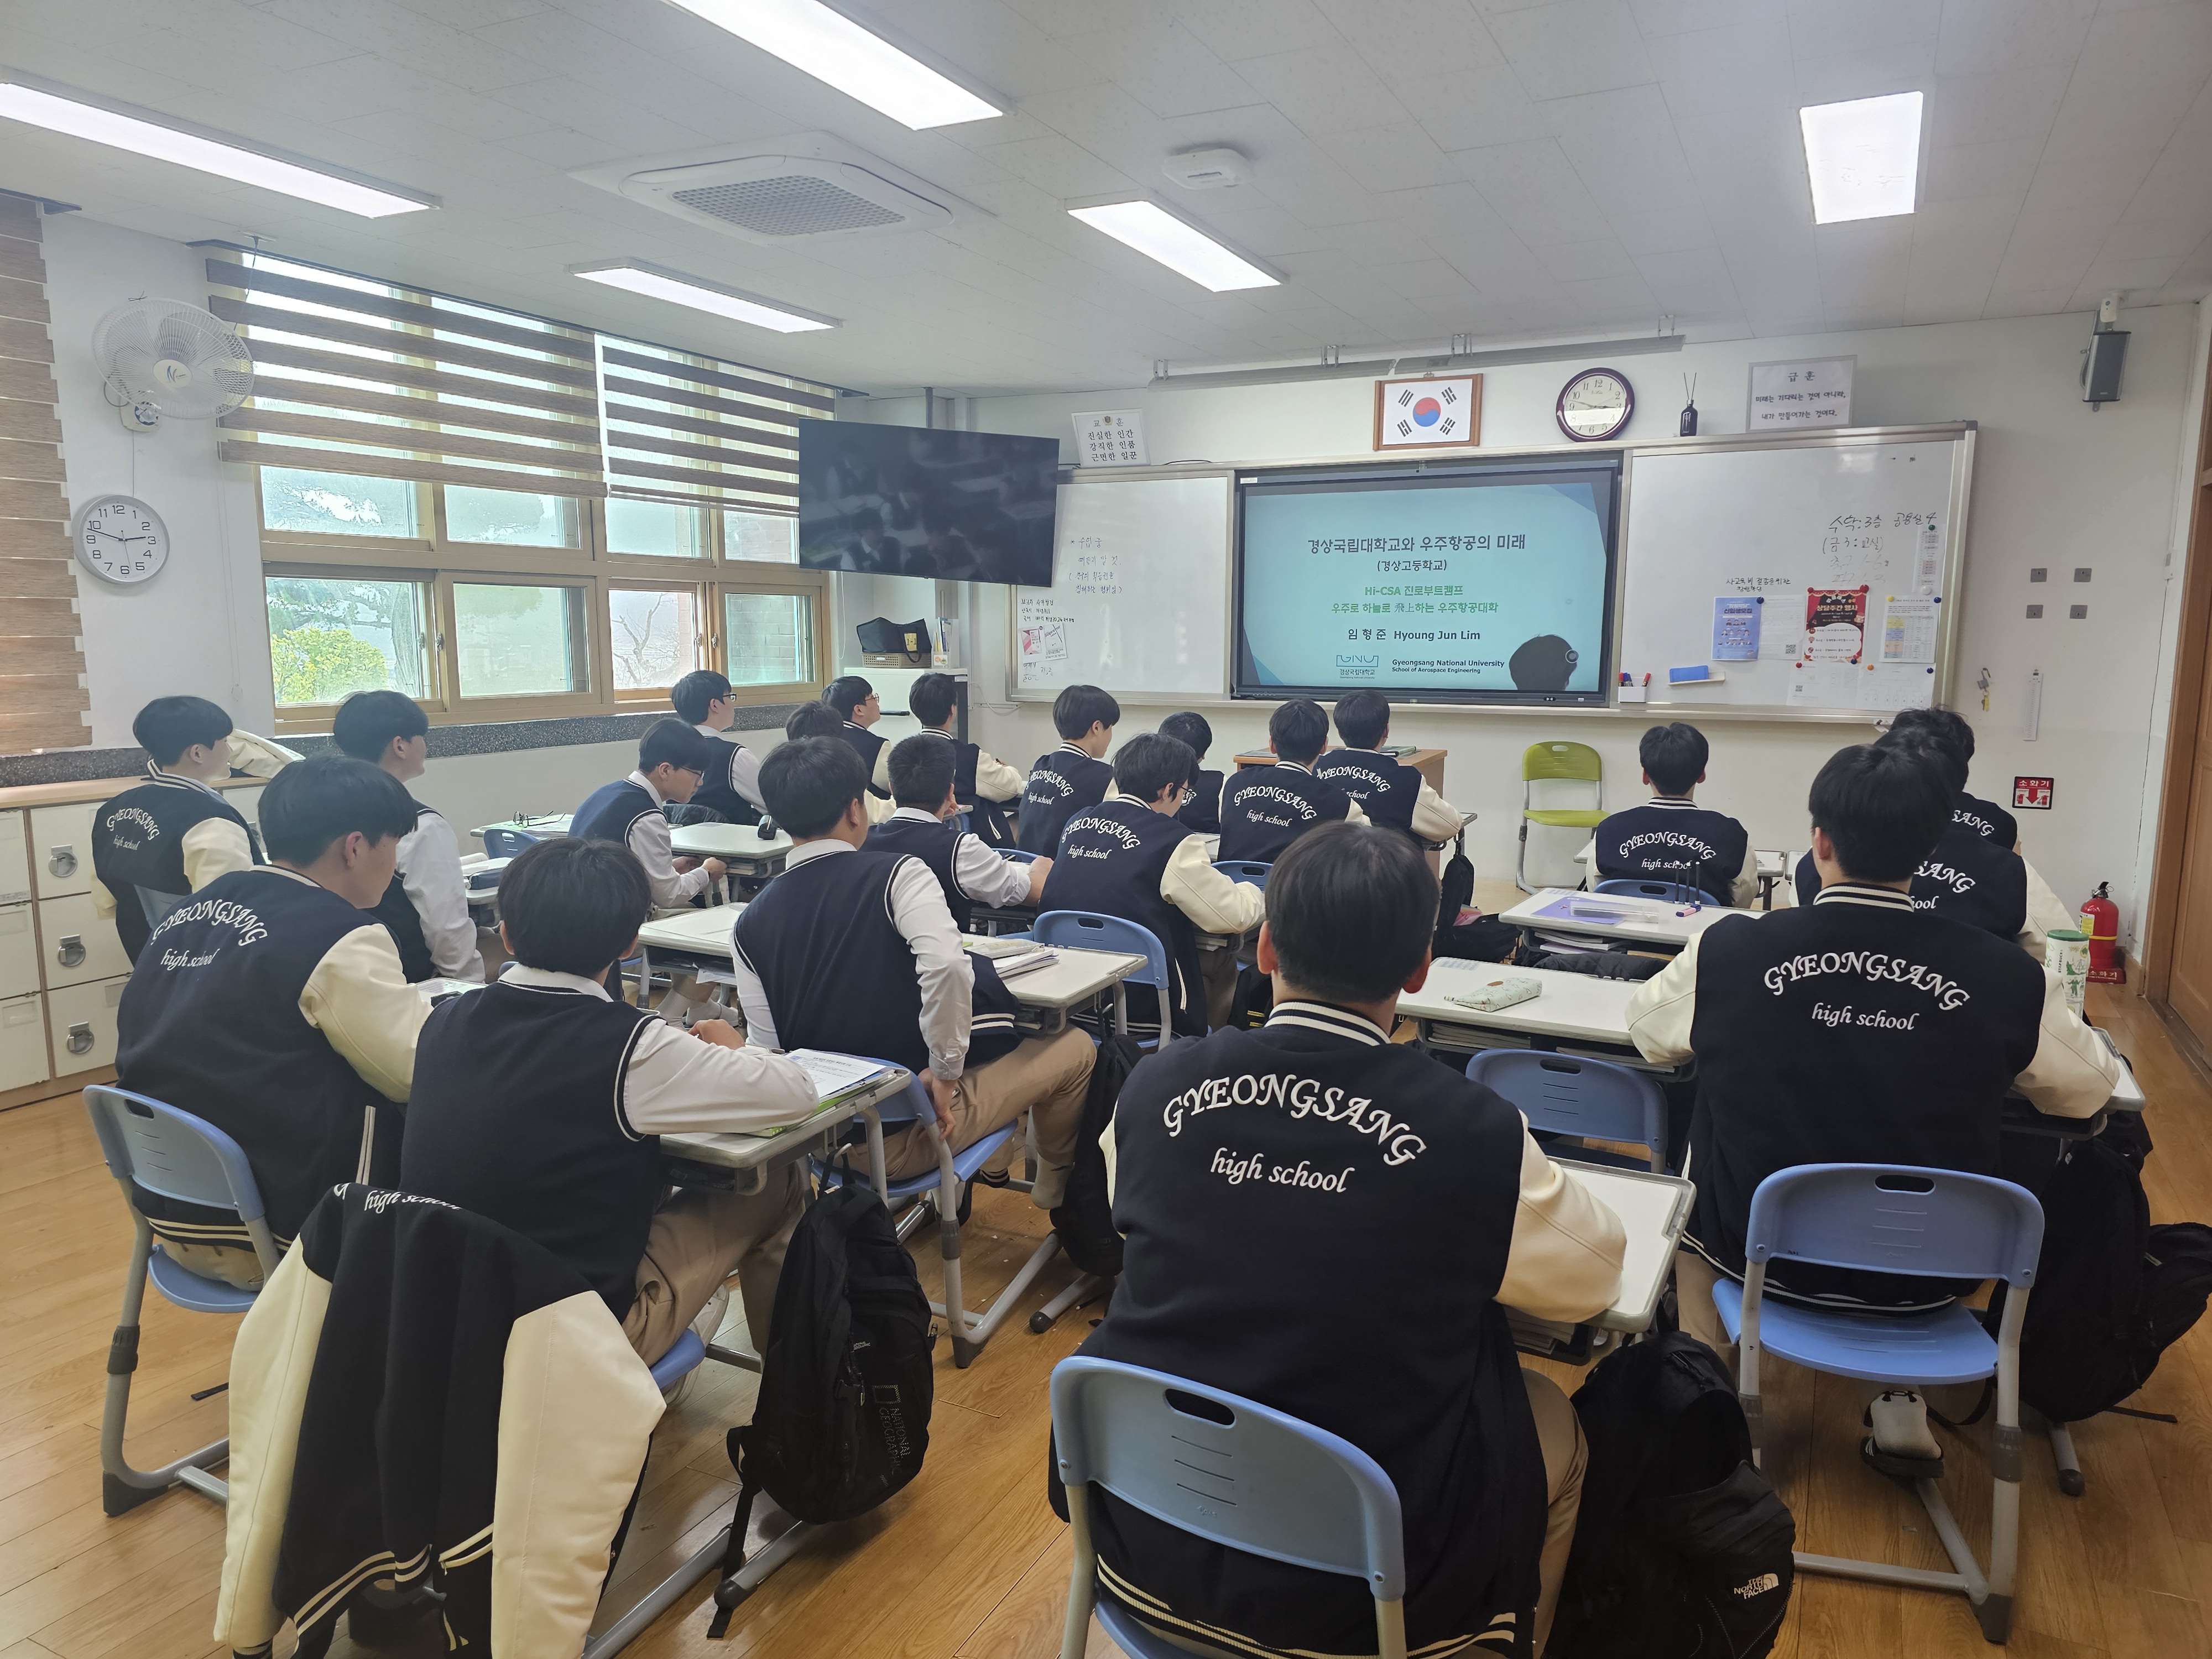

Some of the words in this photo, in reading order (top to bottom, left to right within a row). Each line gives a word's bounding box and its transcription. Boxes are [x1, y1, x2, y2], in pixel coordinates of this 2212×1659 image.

[1788, 372, 1798, 382] 급
[1804, 371, 1815, 381] 훈
[1583, 382, 1589, 390] 11
[1594, 379, 1603, 388] 12
[1609, 382, 1612, 390] 1
[1573, 391, 1580, 399] 10
[1615, 391, 1620, 400] 2
[1778, 393, 1804, 401] 기다리는
[1807, 392, 1820, 400] 것이
[1778, 411, 1811, 420] 만들어가는
[1088, 431, 1112, 440] 진실한
[1118, 429, 1134, 439] 인간
[1589, 426, 1594, 435] 6
[1089, 441, 1114, 451] 강직한
[1119, 440, 1135, 450] 인품
[1092, 452, 1115, 462] 근면한
[1121, 451, 1137, 460] 일꾼
[98, 509, 107, 518] 11
[112, 505, 126, 514] 12
[133, 510, 137, 519] 1
[88, 520, 101, 530] 10
[142, 522, 150, 530] 2
[86, 535, 96, 544] 9
[148, 536, 156, 545] 3
[1308, 538, 1415, 554] 경상국립대학교와
[1420, 535, 1490, 551] 우주항공의
[1497, 534, 1526, 550] 미래
[93, 550, 101, 559] 8
[143, 550, 152, 559] 4
[104, 562, 112, 571] 7
[120, 566, 129, 574] 6
[1377, 560, 1447, 572] (경상고등학교)
[1365, 586, 1401, 596] Hi-CSA
[1404, 585, 1463, 596] 진로부트캠프
[1332, 603, 1359, 613] 우주로
[1362, 603, 1391, 613] 하늘로
[1395, 602, 1434, 613] 飛上하는
[1438, 602, 1499, 613] 우주항공대학
[1348, 628, 1358, 640] 임
[1362, 628, 1372, 640] 형
[1376, 629, 1386, 640] 준
[1394, 630, 1434, 641] Hyoung
[1438, 630, 1457, 640] Jun
[1460, 630, 1480, 640] Lim
[1028, 792, 1037, 804] high
[1037, 795, 1055, 805] school
[1234, 786, 1317, 820] GYEONGSANG
[1246, 810, 1265, 823] high
[1264, 815, 1293, 827] school
[1061, 817, 1141, 849] GYEONGSANG
[1619, 831, 1717, 860] GYEONGSANG
[1068, 844, 1085, 859] high
[1084, 848, 1112, 859] school
[1641, 858, 1662, 870] high
[160, 948, 188, 971] high
[187, 948, 220, 967] school
[1764, 951, 1970, 1010] GYEONGSANG
[1812, 1002, 1853, 1027] high
[1856, 1010, 1920, 1030] school
[1163, 1073, 1427, 1166] GYEONGSANG
[1210, 1147, 1265, 1185] high
[1268, 1160, 1355, 1193] school
[364, 1190, 401, 1214] high
[1748, 1575, 1764, 1584] THE
[1734, 1579, 1763, 1594] NORTH
[1744, 1585, 1764, 1599] FACE
